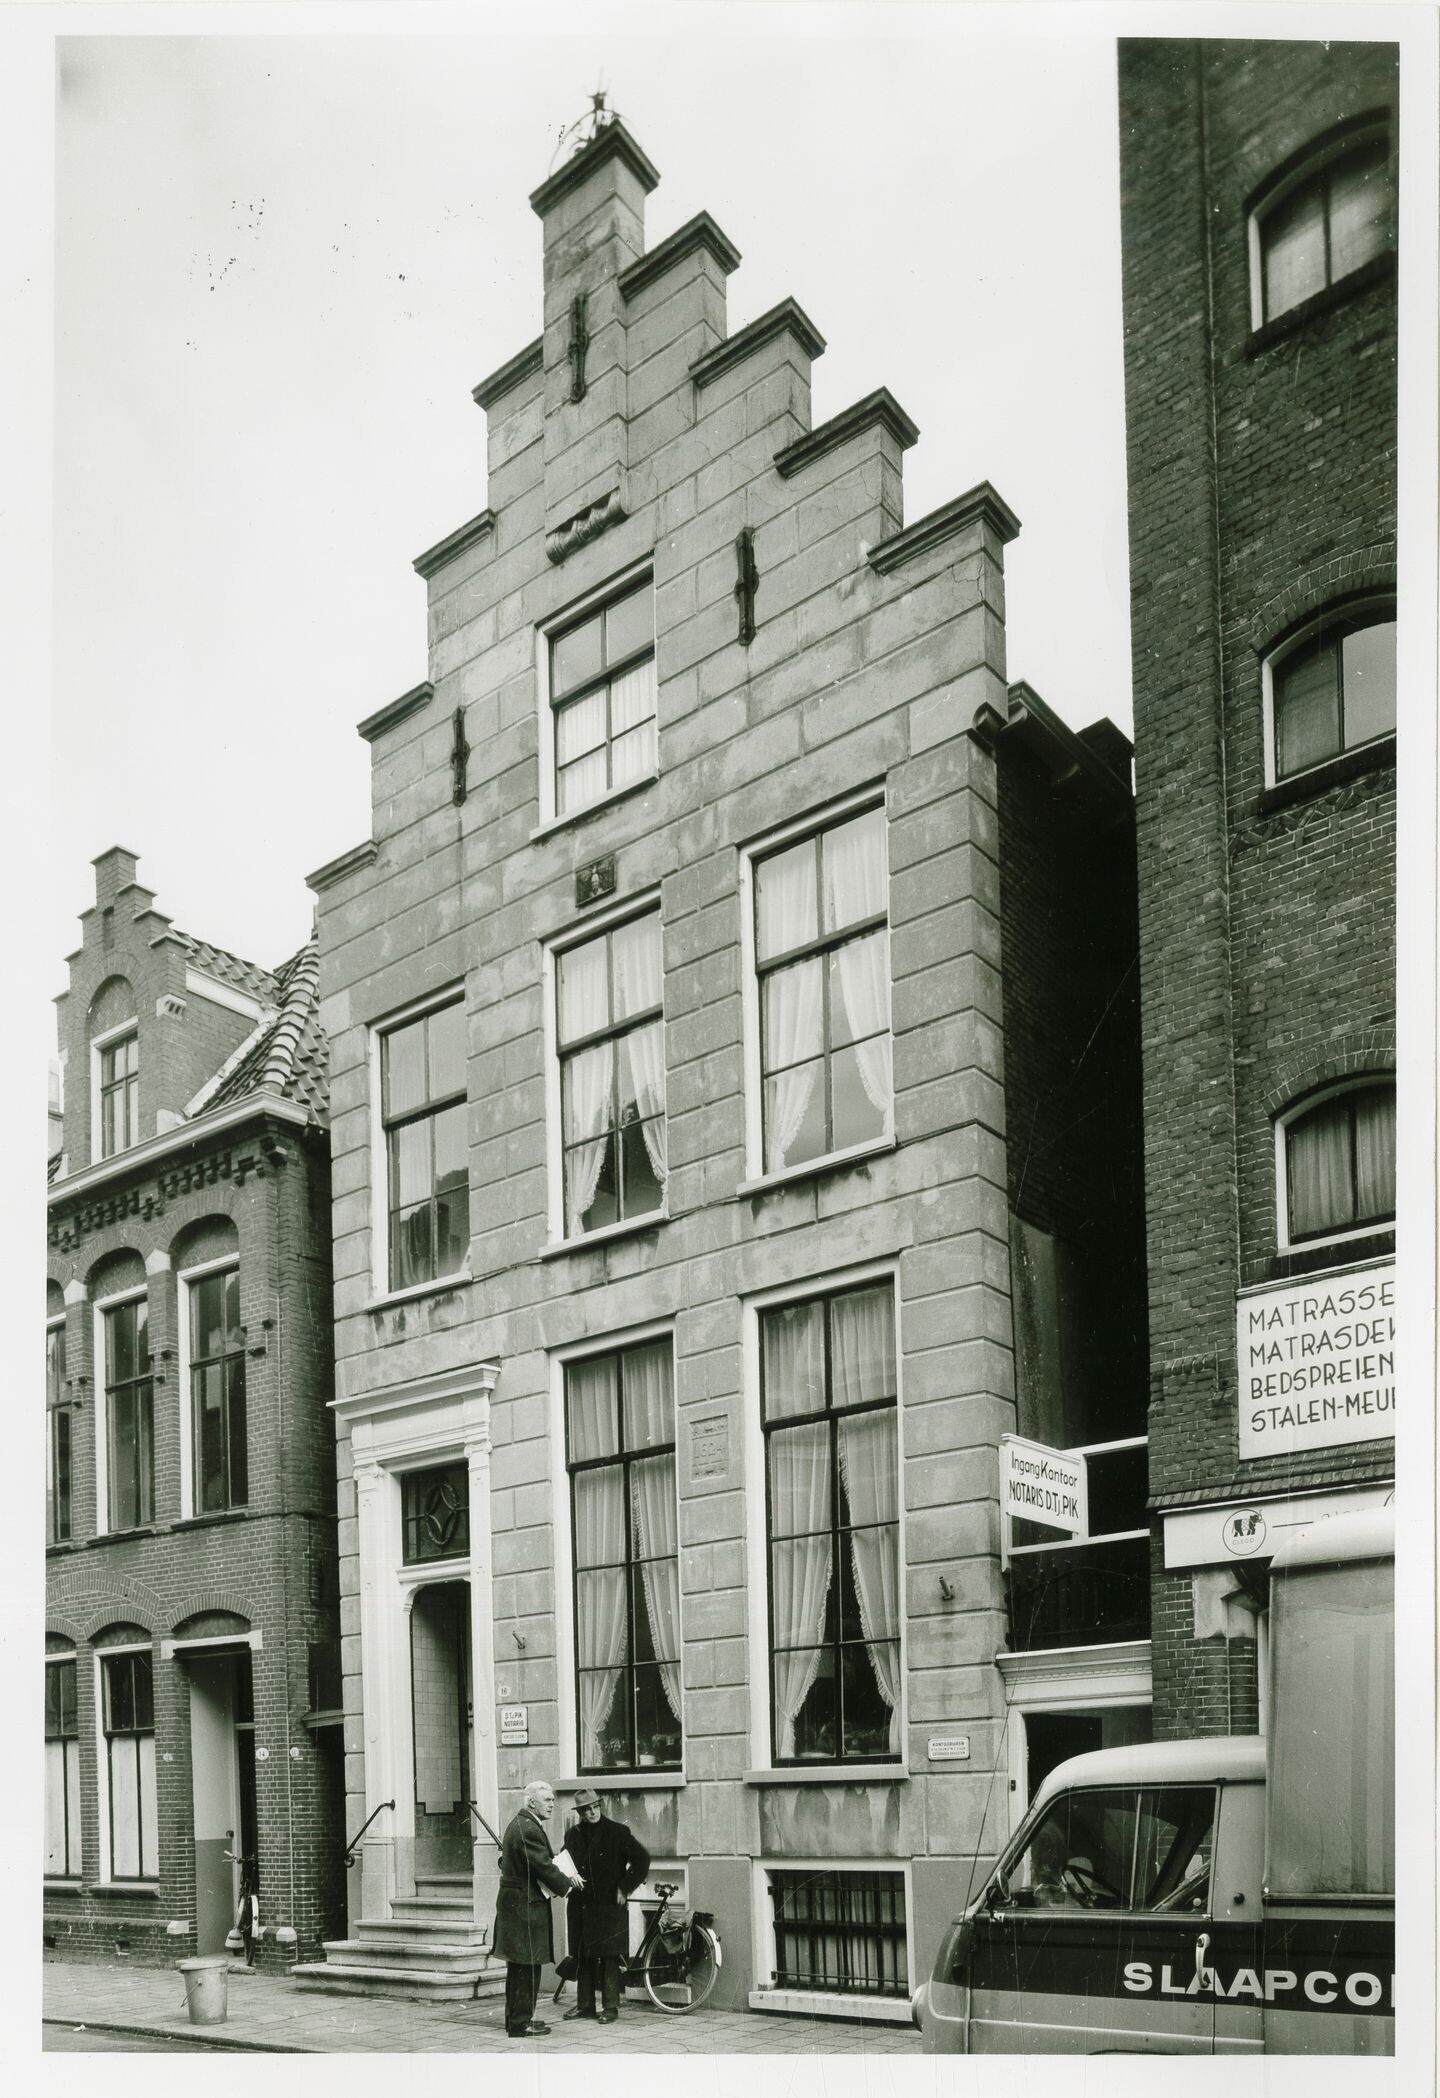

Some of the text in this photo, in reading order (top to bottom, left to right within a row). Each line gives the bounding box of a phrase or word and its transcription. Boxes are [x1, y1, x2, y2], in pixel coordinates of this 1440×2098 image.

[1249, 1280, 1395, 1334] MATRASSE
[1250, 1351, 1395, 1400] BEDSPREIEN
[1251, 1386, 1395, 1432] STALEN-MEU
[1011, 1450, 1078, 1488] Ingang Kantoor
[1009, 1480, 1044, 1508] NOTARIS
[1123, 1962, 1395, 2007] SLAAPCO
